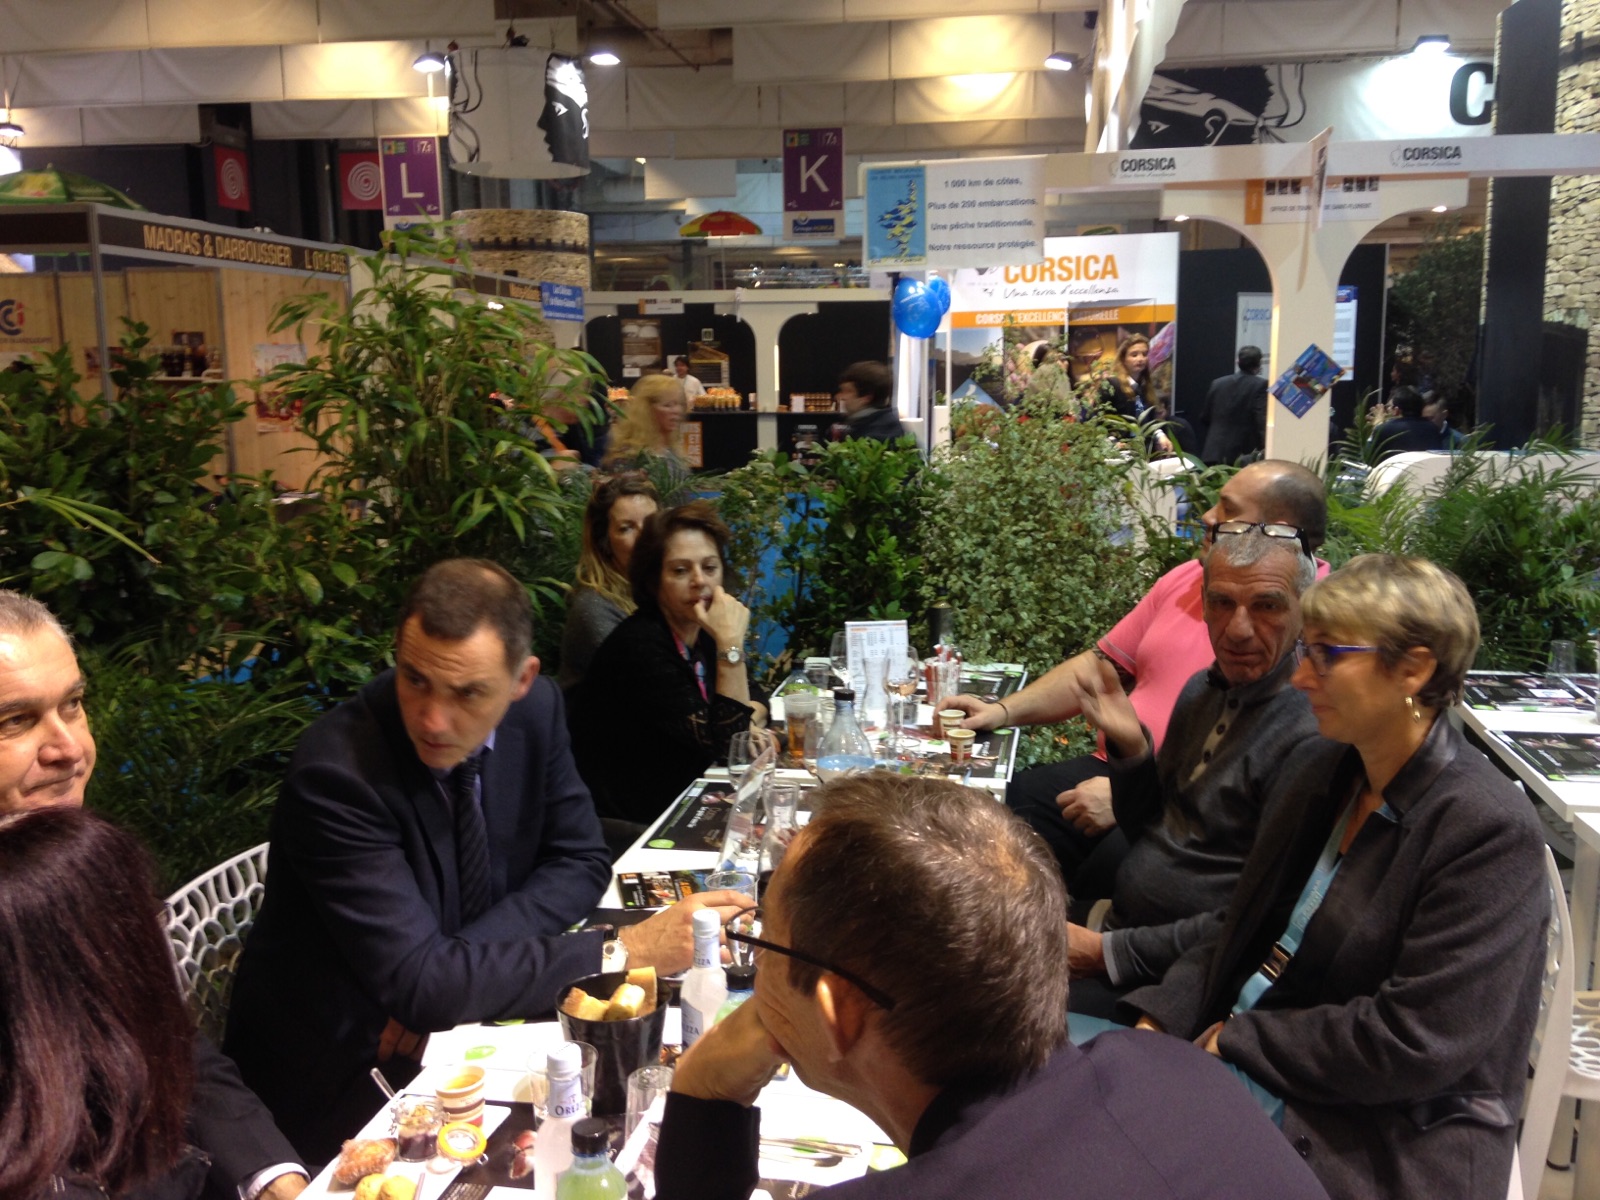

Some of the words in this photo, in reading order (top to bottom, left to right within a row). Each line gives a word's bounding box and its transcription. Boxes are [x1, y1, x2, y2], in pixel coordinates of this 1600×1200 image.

[1403, 145, 1461, 160] CORSICA
[1121, 157, 1176, 172] CORSICA
[400, 162, 425, 198] L
[800, 154, 829, 193] K
[968, 179, 982, 187] km
[983, 178, 994, 187] de
[928, 202, 947, 210] Plus
[948, 201, 959, 209] de
[931, 223, 947, 231] Une
[949, 221, 975, 232] pêche
[143, 225, 200, 256] MADRAS
[203, 234, 213, 257] &
[215, 236, 293, 267] DARBOUSSIER
[928, 242, 951, 251] Notre
[953, 242, 995, 251] ressource
[1003, 254, 1119, 284] CORSICA
